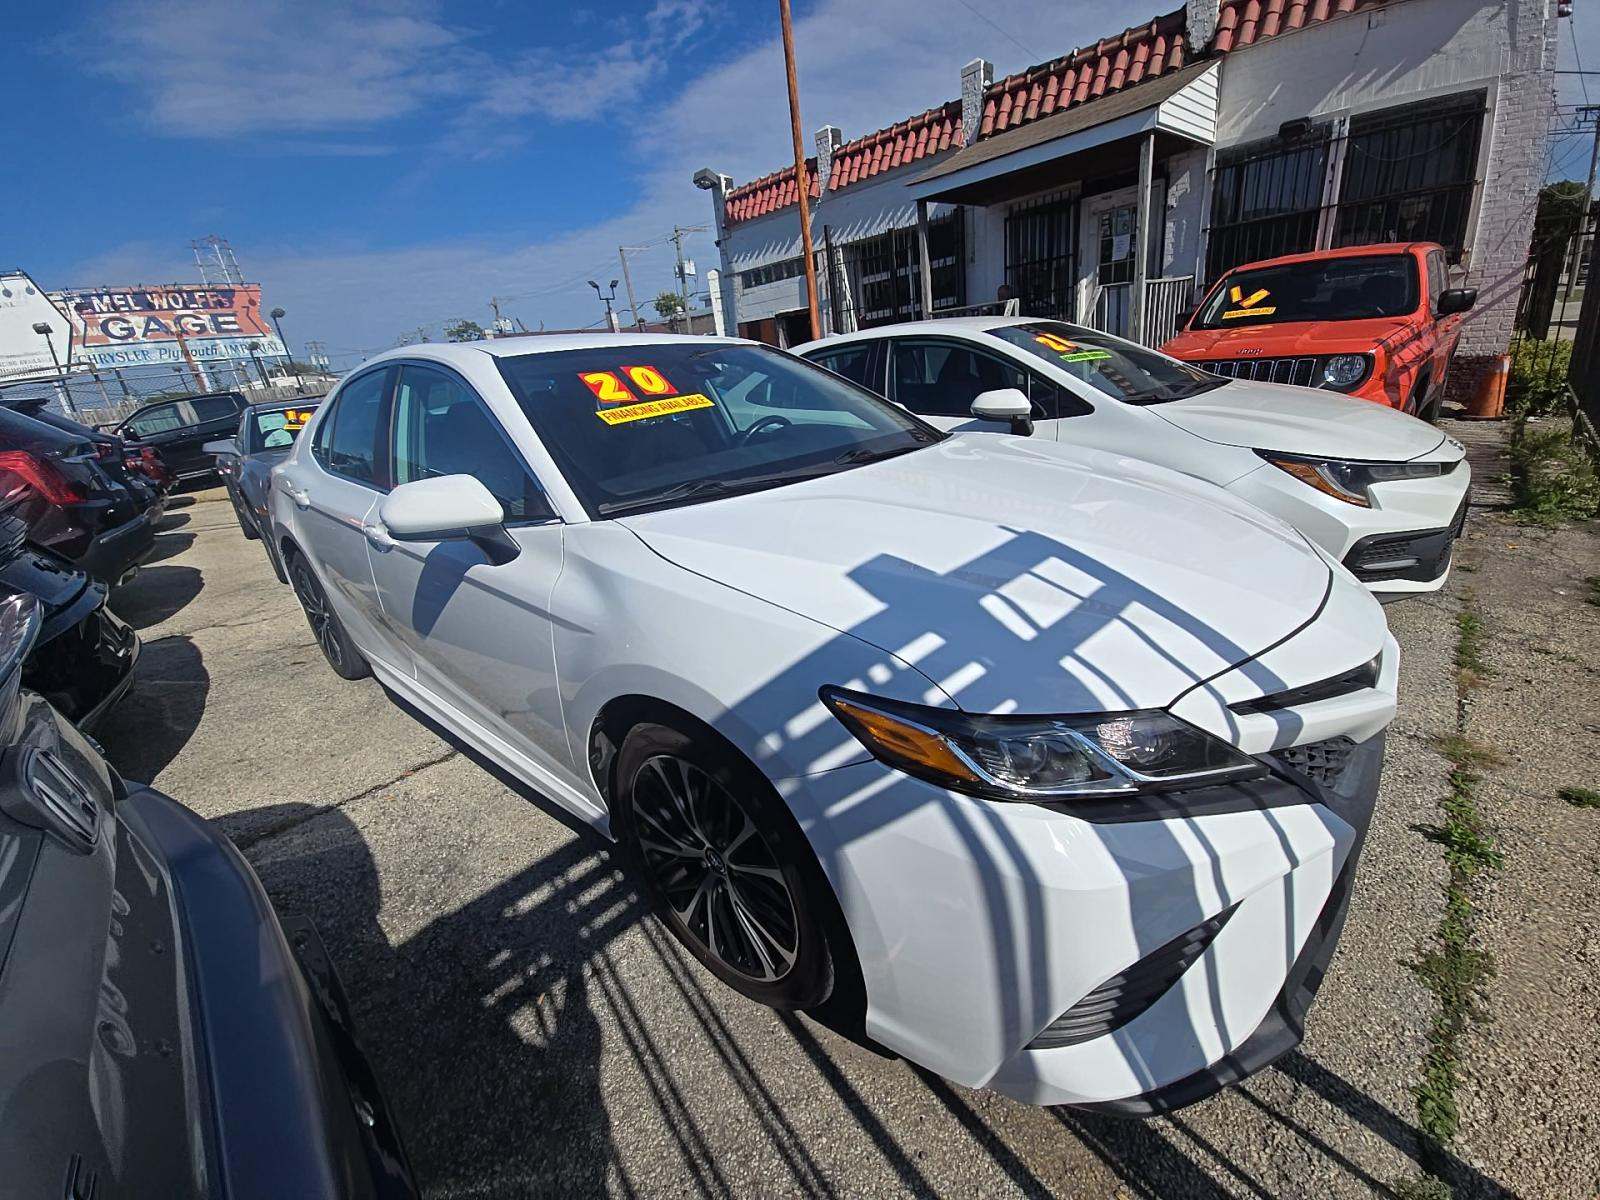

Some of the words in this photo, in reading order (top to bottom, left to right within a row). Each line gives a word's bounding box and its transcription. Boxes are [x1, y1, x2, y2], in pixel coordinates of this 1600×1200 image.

[91, 294, 143, 312] MEL
[100, 313, 243, 340] GAGE
[78, 350, 153, 366] CHRYSLER
[583, 366, 670, 402] 20
[602, 404, 660, 421] FINANCING
[656, 395, 709, 412] AVAILABLE
